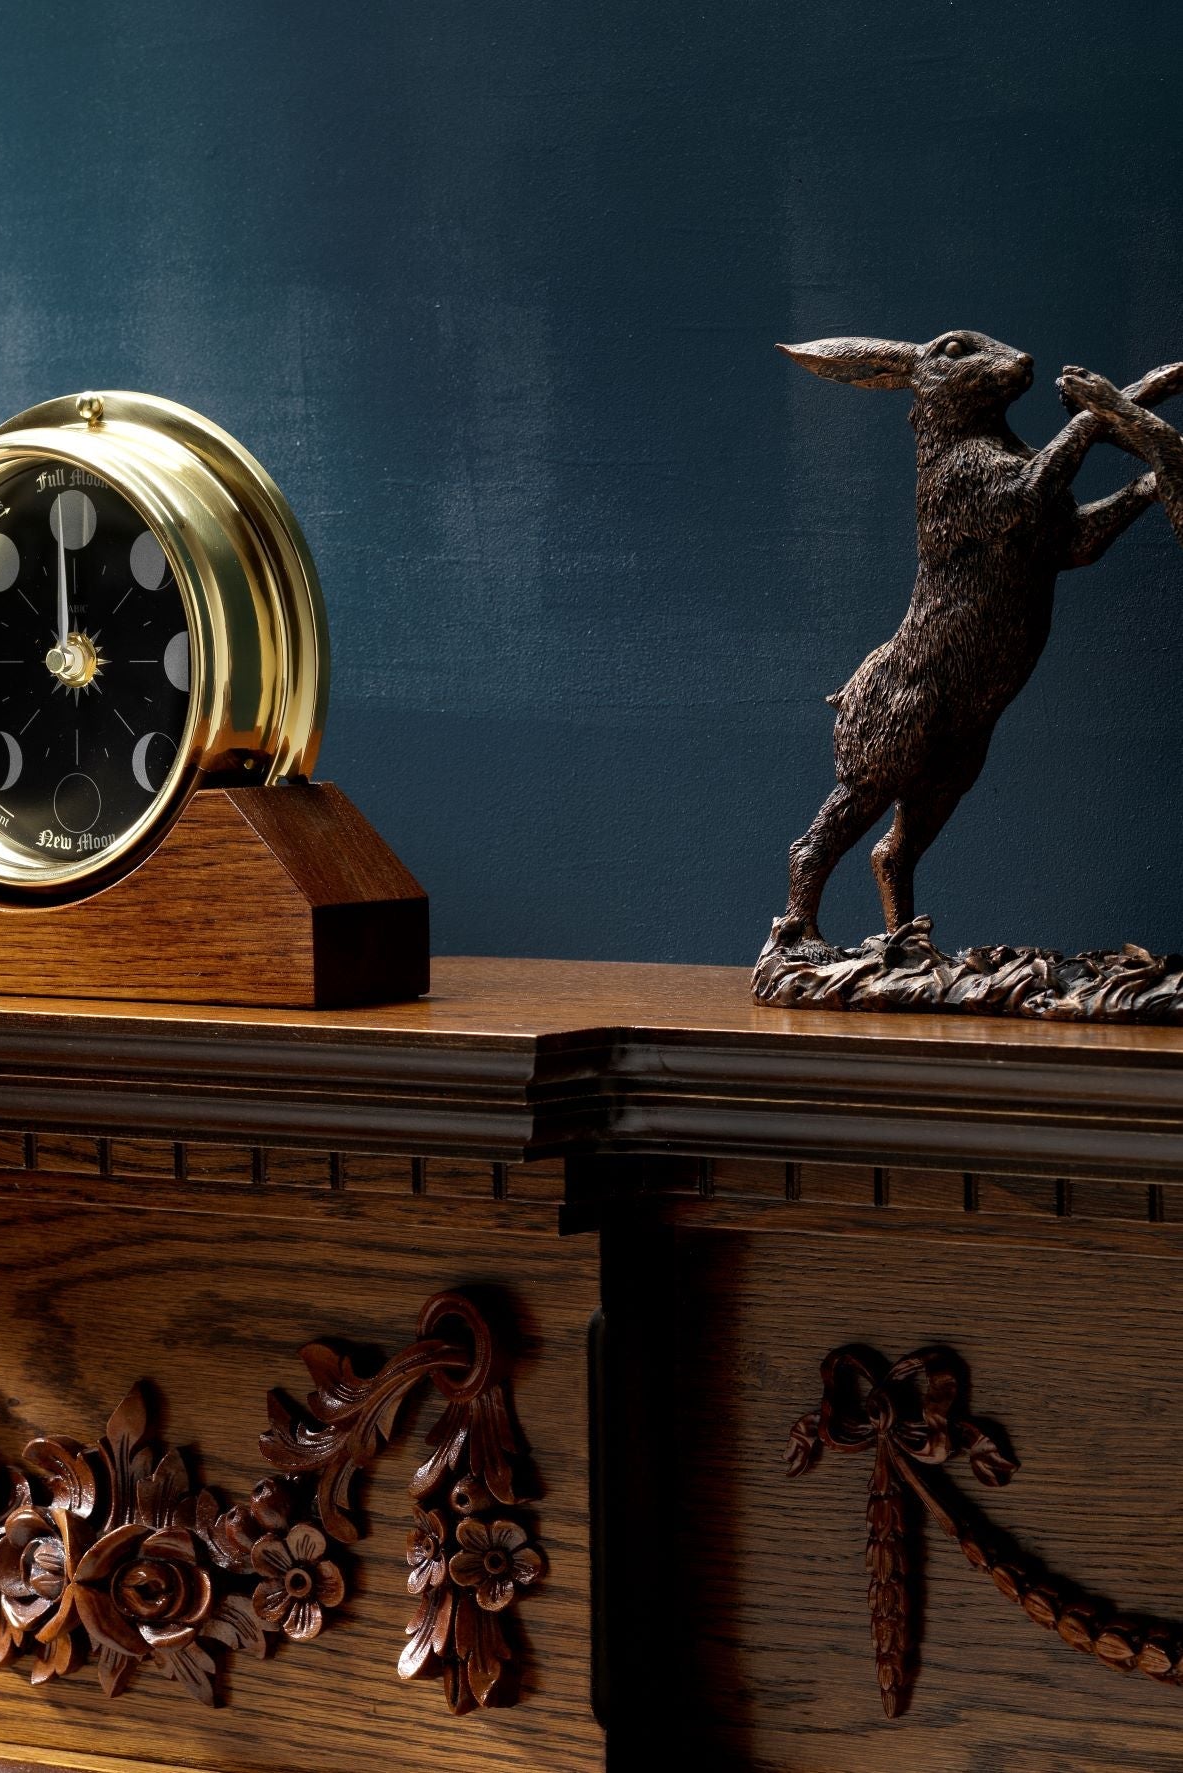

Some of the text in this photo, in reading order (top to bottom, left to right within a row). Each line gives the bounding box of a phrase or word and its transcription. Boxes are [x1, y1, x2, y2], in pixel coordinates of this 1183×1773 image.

[36, 468, 66, 494] Full
[35, 829, 116, 853] New Moon
